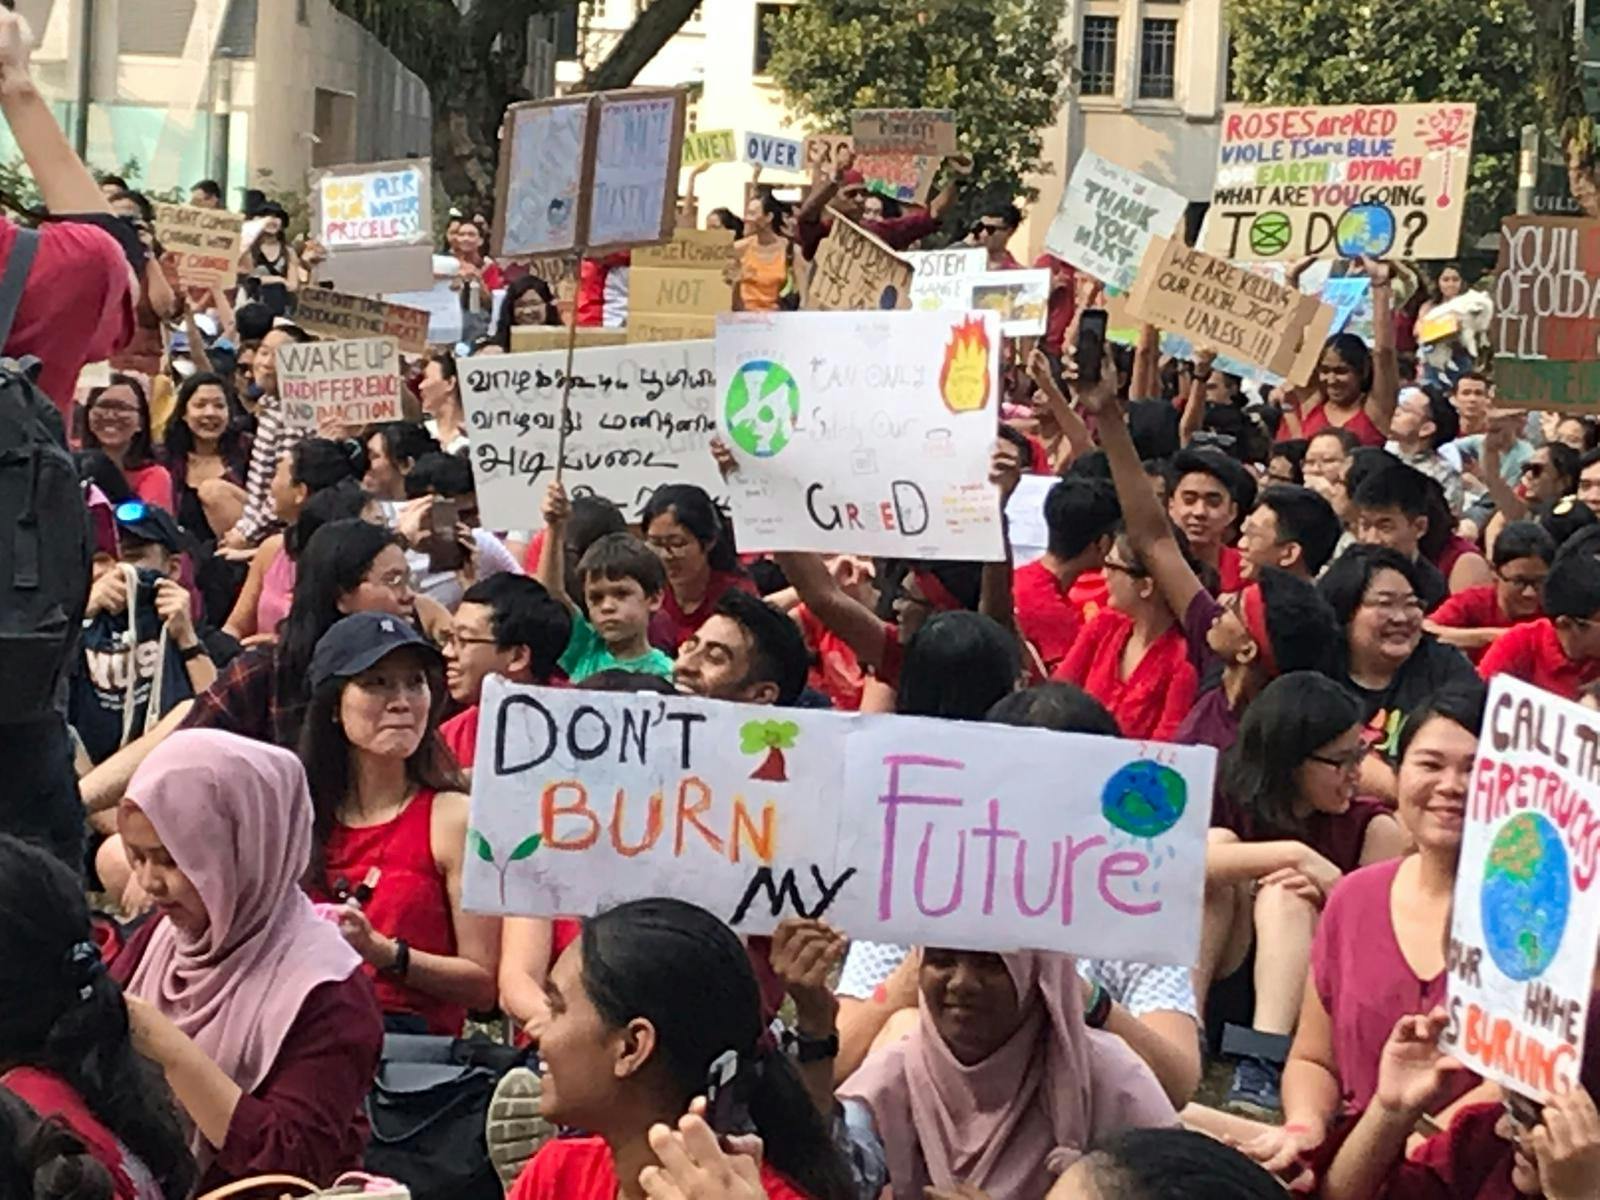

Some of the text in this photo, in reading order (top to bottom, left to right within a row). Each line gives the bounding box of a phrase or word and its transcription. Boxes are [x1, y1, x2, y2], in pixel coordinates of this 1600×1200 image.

[1226, 110, 1317, 142] ROSES
[1351, 108, 1397, 136] RED
[747, 137, 797, 167] OVER
[1346, 138, 1395, 157] BLUE
[373, 173, 415, 198] AIR
[1256, 160, 1330, 184] EARTH
[1346, 158, 1422, 181] DYING!
[1083, 178, 1160, 232] THANK
[1214, 184, 1426, 207] WHAT ARE YOU GOING
[326, 216, 418, 242] PRICELESS
[1073, 225, 1134, 266] NEXT
[1157, 272, 1190, 295] OUR
[1171, 250, 1200, 273] WE
[1202, 256, 1235, 289] ARE
[656, 279, 705, 307] NOT
[1184, 306, 1247, 349] UNLESS
[279, 341, 394, 373] WAKE UP
[283, 373, 400, 401] INDIFFERENC
[285, 400, 395, 422] AND INACTION
[496, 693, 706, 775] DON'T
[1492, 692, 1569, 768] CALL
[540, 776, 777, 864] BURN
[878, 754, 1163, 926] Future
[729, 864, 857, 925] MY
[1465, 1003, 1577, 1098] BURNING
